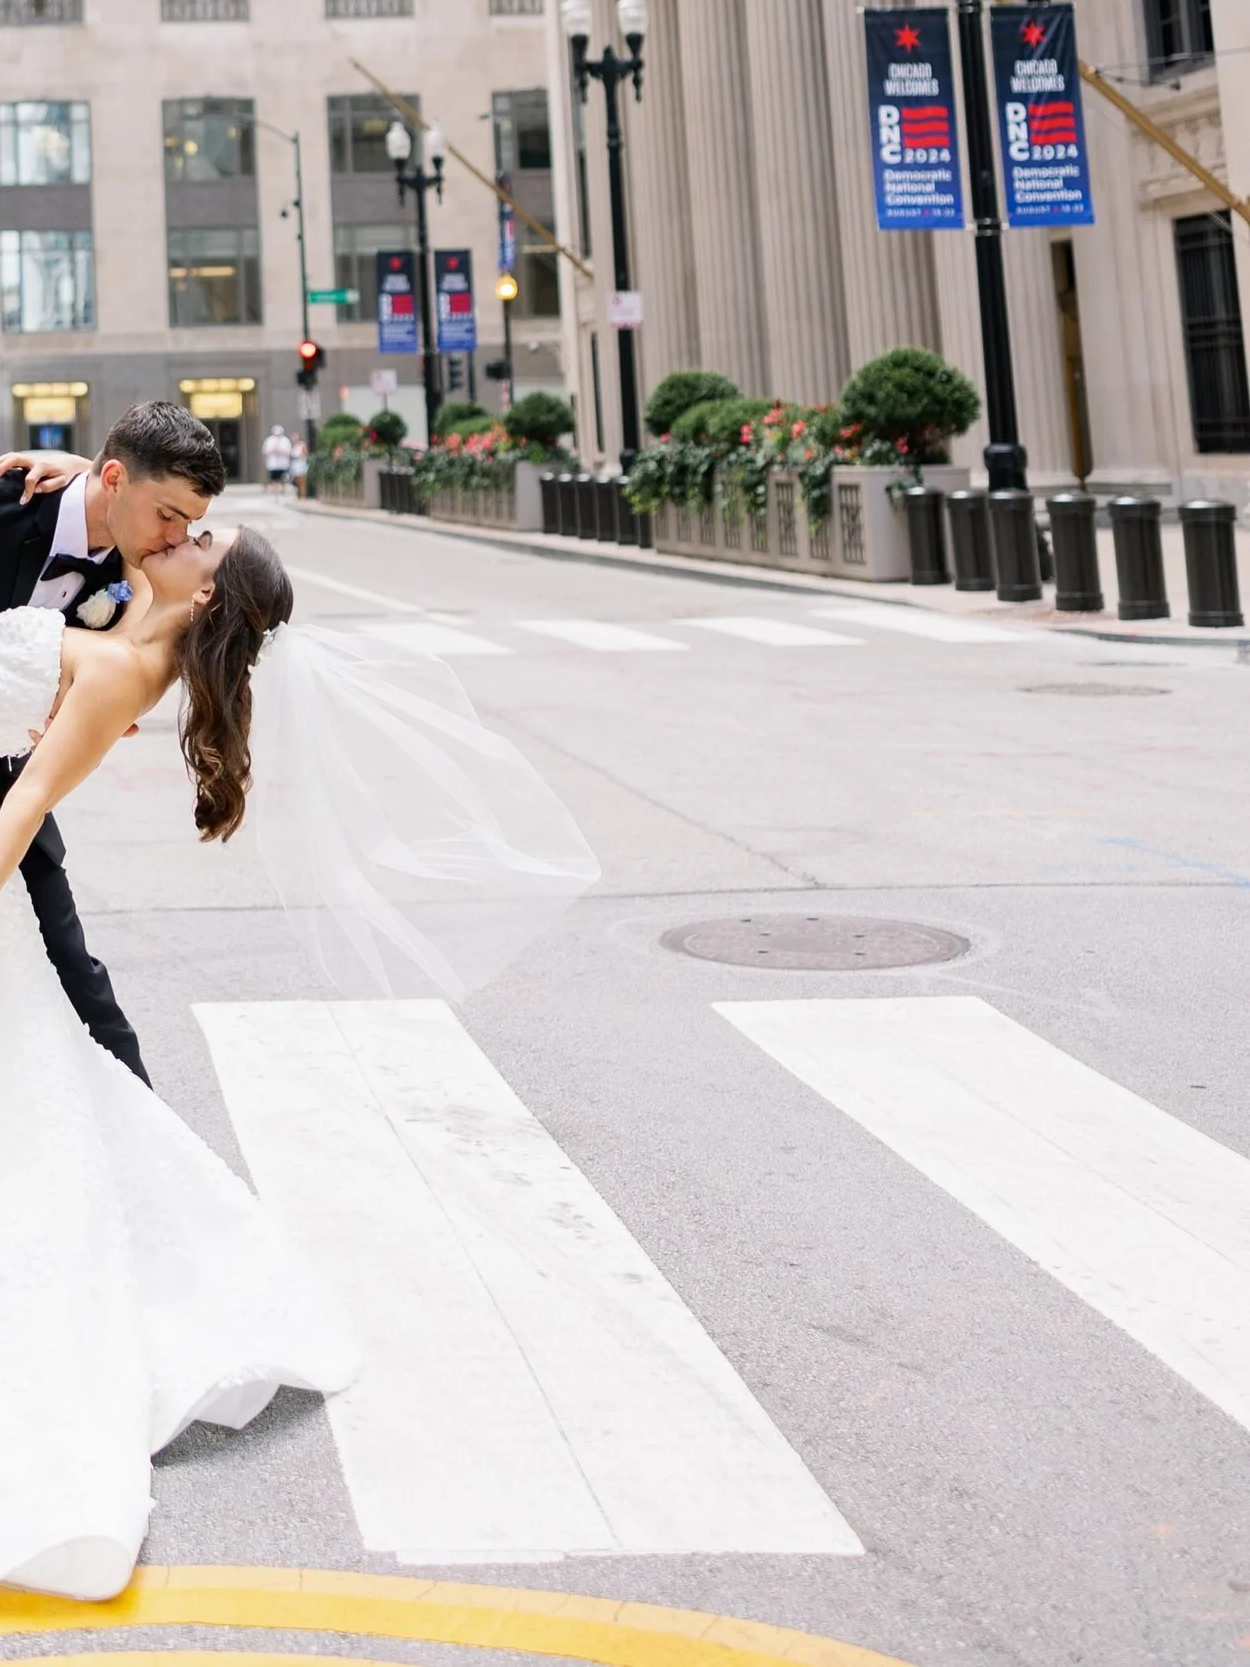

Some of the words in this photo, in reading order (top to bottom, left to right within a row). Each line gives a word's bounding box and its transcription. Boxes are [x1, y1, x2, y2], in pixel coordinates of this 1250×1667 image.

[888, 62, 932, 79] CHICAGO
[1014, 58, 1058, 76] CHICAGO
[883, 78, 939, 96] WELCOMES
[1010, 75, 1065, 94] WELCOMES
[903, 148, 951, 164] 2024
[1031, 144, 1079, 161] 2024
[883, 168, 952, 182] Democratic
[1013, 164, 1080, 179] Democratic
[885, 181, 935, 193] National
[1014, 177, 1064, 191] National
[885, 193, 955, 207] Convention
[1014, 189, 1083, 204] Convention
